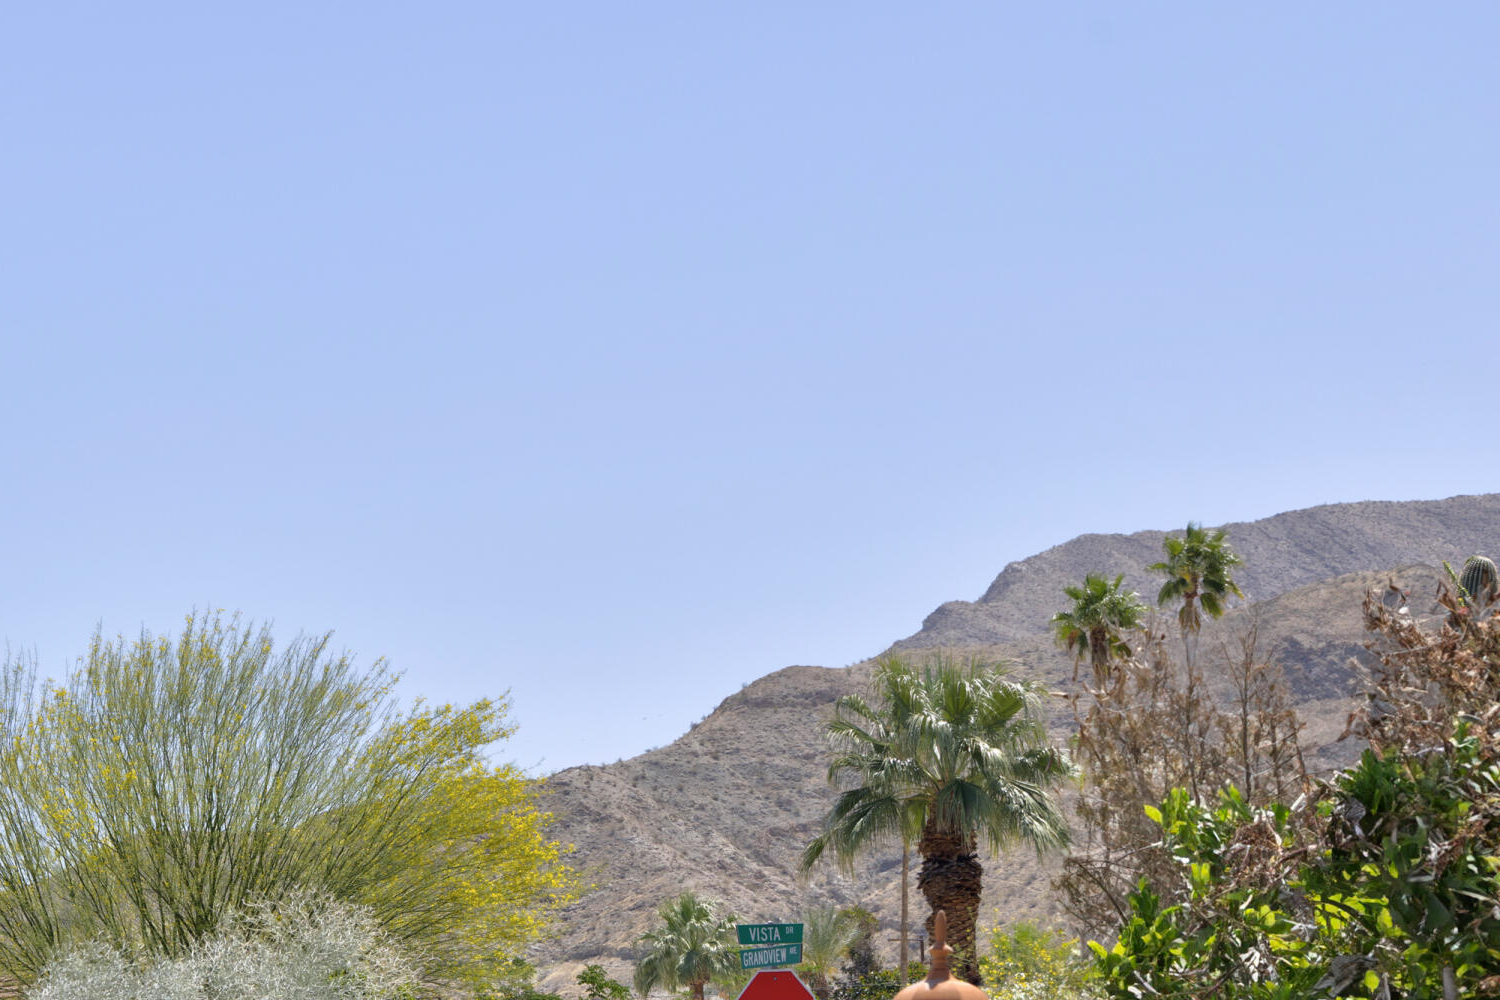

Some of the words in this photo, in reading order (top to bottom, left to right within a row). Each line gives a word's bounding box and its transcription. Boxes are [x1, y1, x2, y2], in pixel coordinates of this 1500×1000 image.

[749, 927, 781, 941] VISTA
[785, 926, 794, 934] DR
[743, 948, 787, 967] GRANDVIEW
